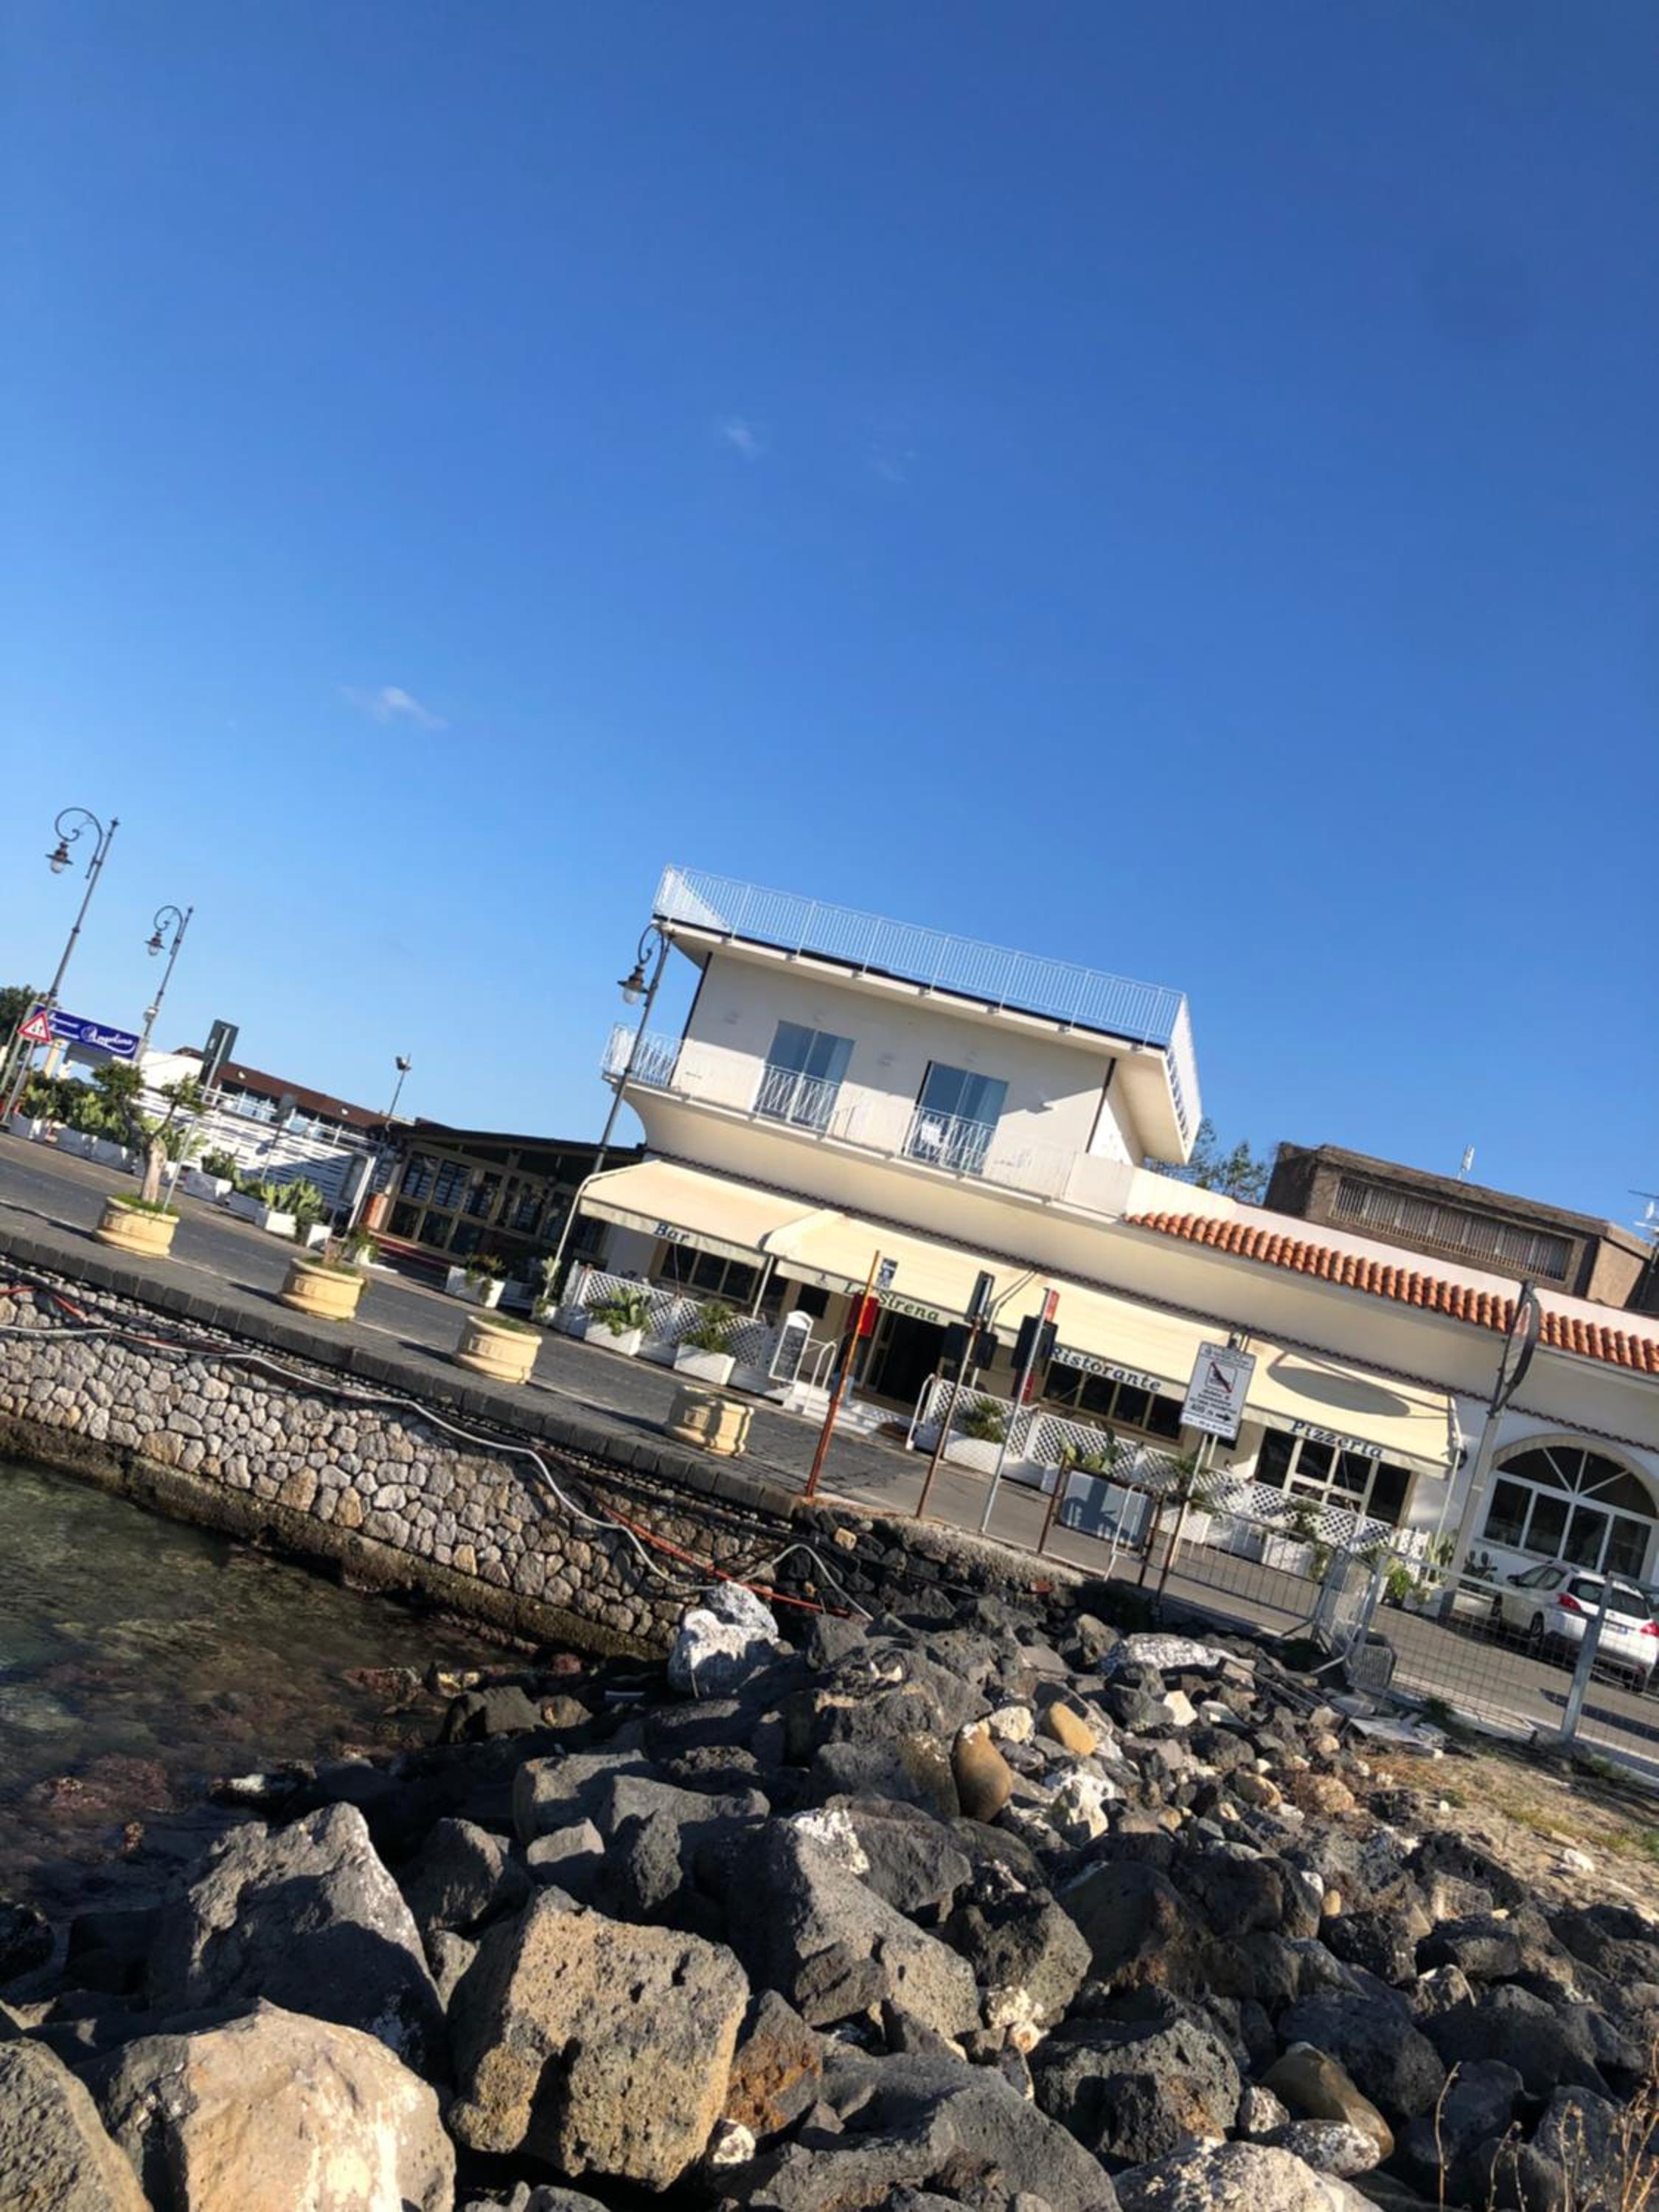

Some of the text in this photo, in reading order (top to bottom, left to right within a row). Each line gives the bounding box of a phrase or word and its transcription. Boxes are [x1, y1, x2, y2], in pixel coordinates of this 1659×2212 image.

[653, 1222, 689, 1243] Bar
[877, 1290, 940, 1321] Sirena
[1050, 1346, 1162, 1393] Ristorante
[1290, 1419, 1383, 1458] Pizzeria
